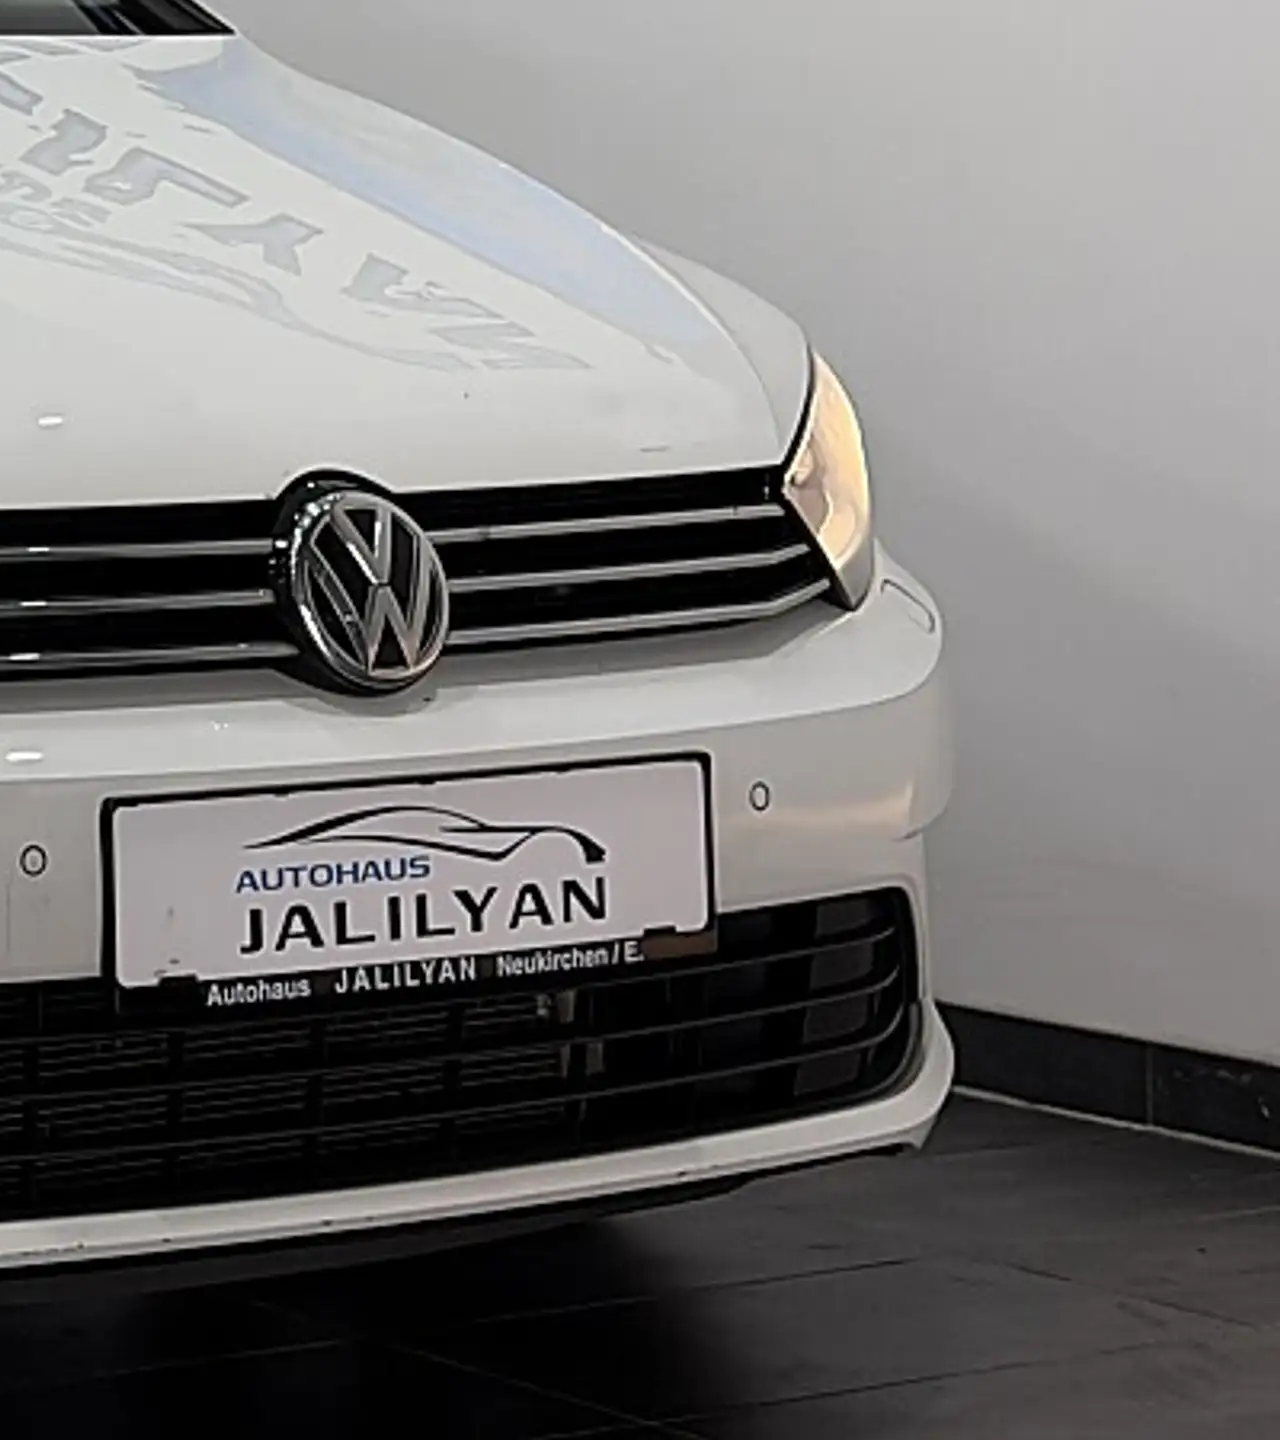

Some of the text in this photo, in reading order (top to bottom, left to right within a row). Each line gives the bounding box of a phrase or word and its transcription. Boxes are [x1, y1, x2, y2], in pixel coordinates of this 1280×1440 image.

[302, 500, 438, 678] VW
[236, 855, 431, 894] AUTOHAUS
[240, 877, 606, 954] JALILYAN
[206, 978, 312, 1007] Autohaus
[334, 956, 477, 994] JALILYAN
